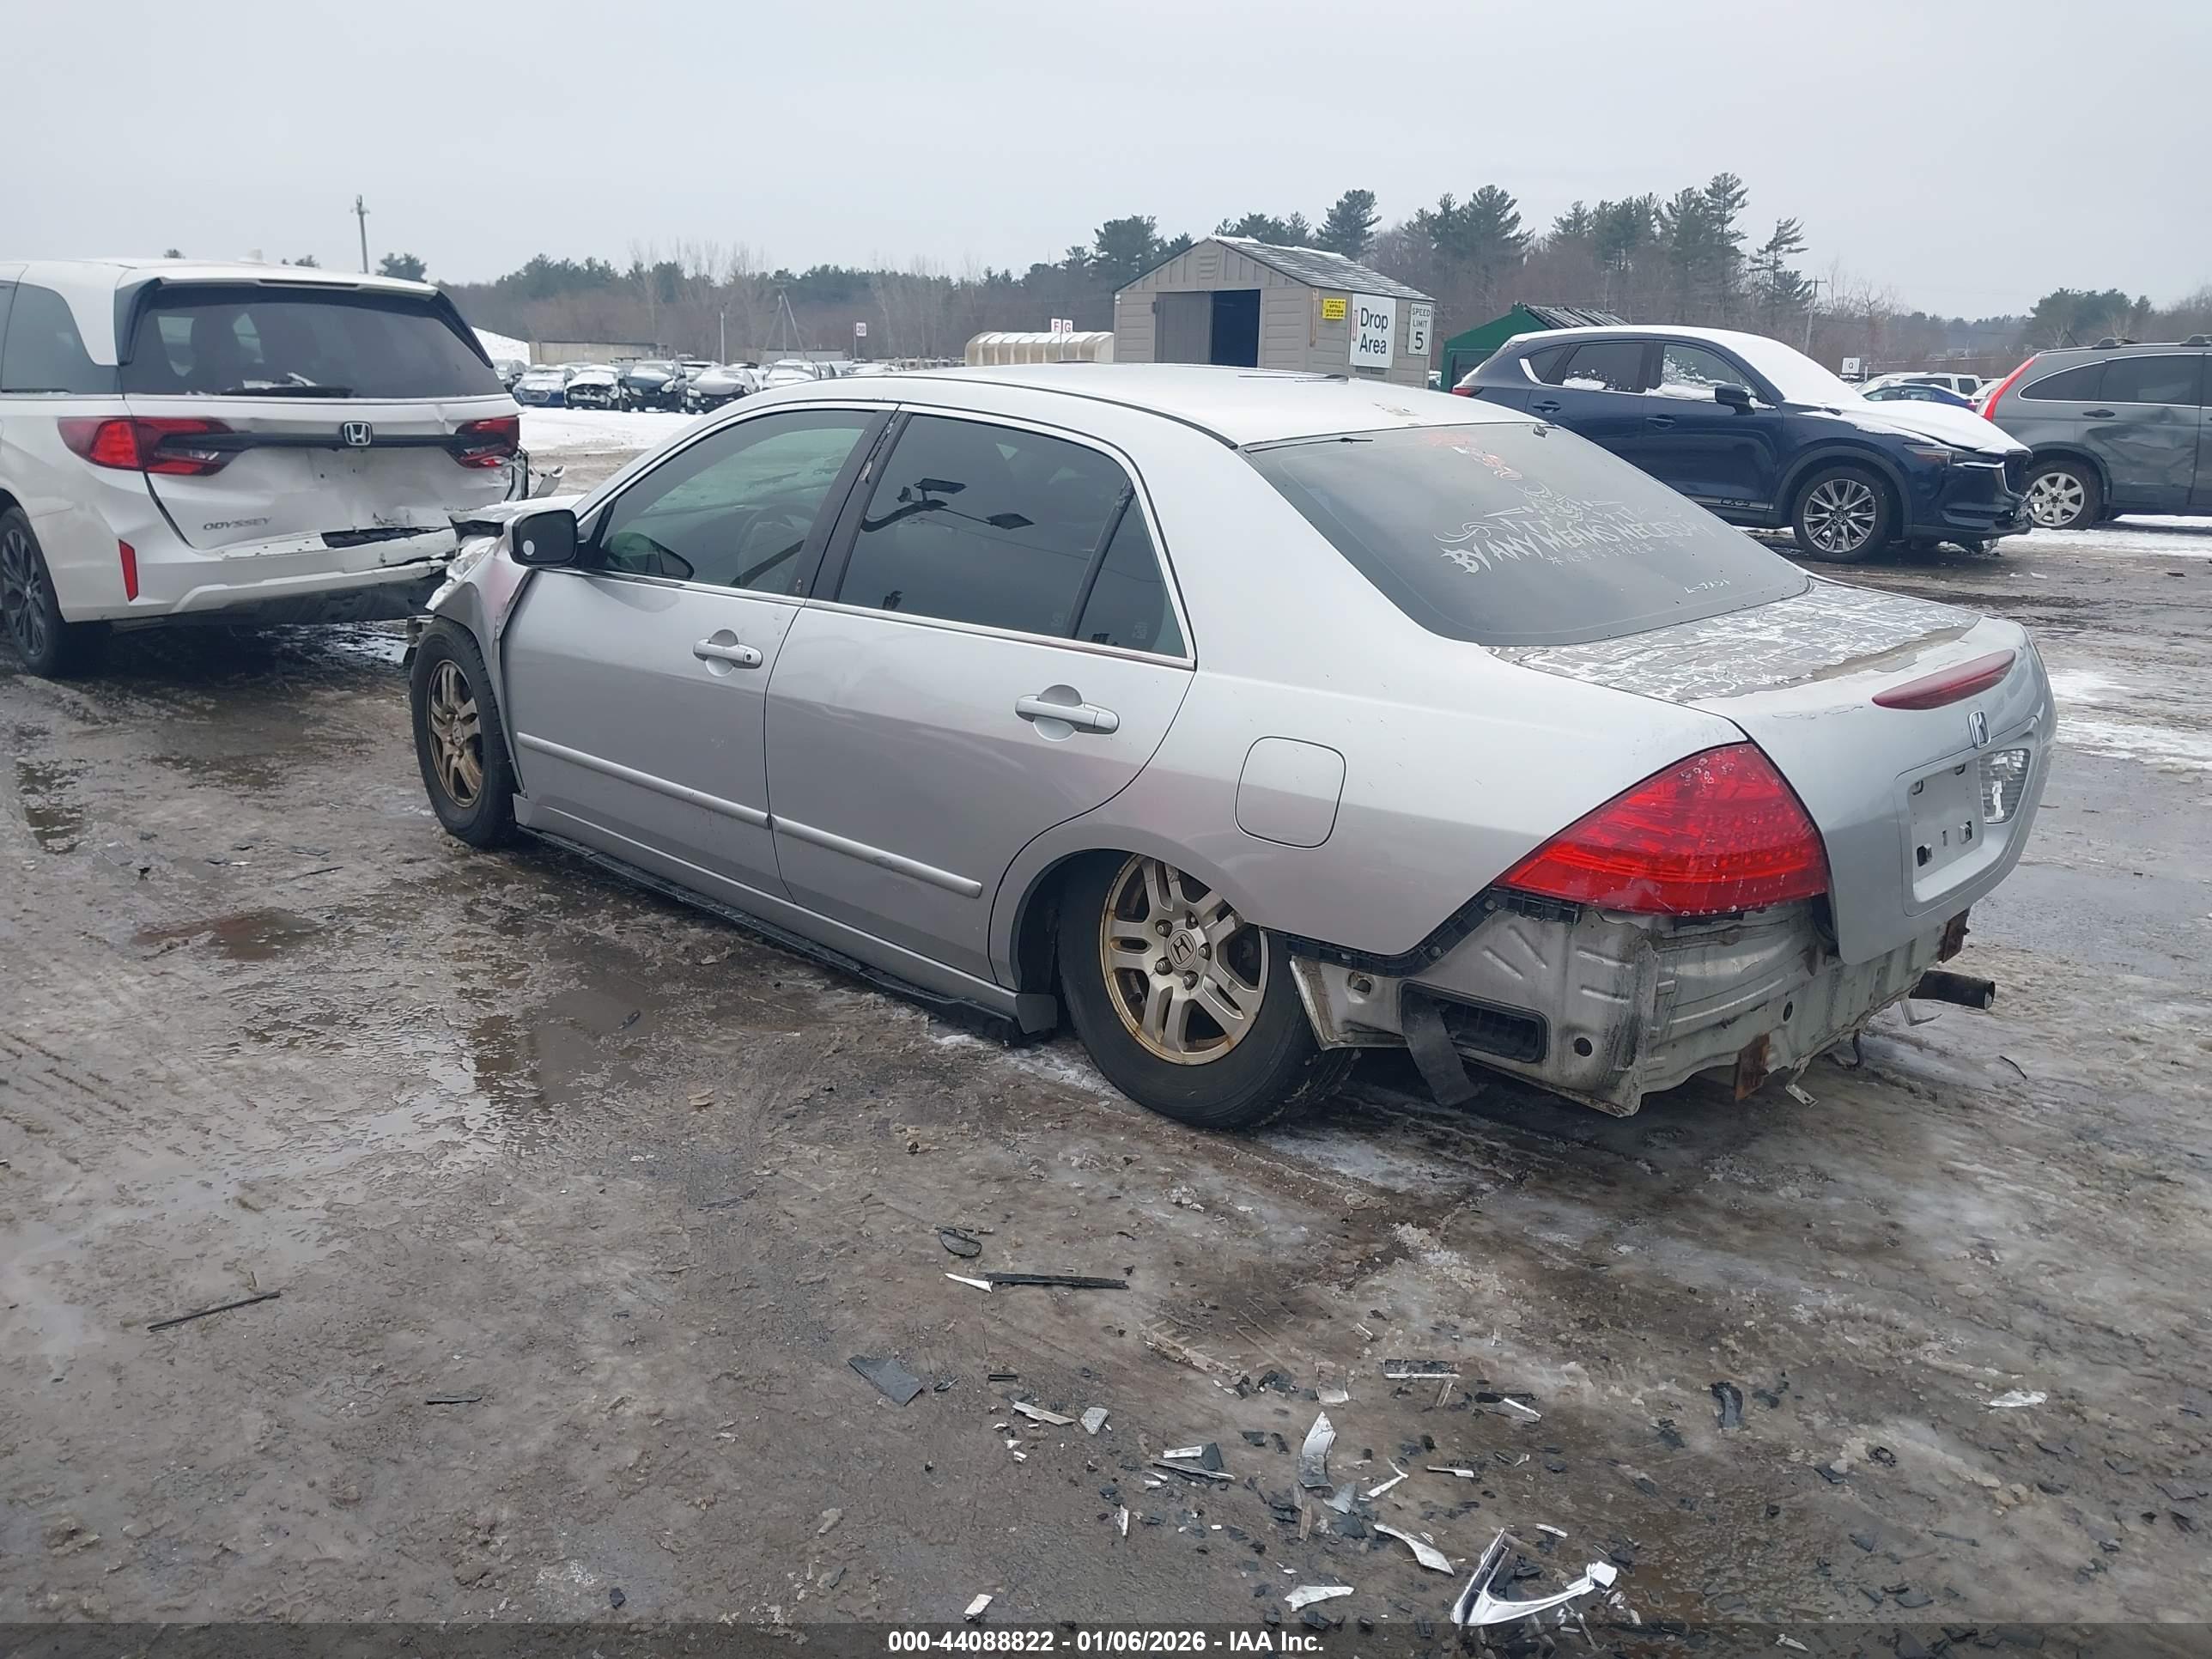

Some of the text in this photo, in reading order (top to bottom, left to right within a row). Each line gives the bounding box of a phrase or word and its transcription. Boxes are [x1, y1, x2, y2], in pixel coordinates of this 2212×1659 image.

[1360, 307, 1389, 333] Drop
[1412, 307, 1431, 317] SPEED
[1065, 322, 1072, 332] G
[1413, 319, 1429, 327] LIMIT
[1359, 332, 1387, 354] Area
[1415, 331, 1424, 350] 5
[204, 517, 272, 531] ODYSSEY
[1441, 542, 1492, 574] BY
[1485, 532, 1543, 562] ANY
